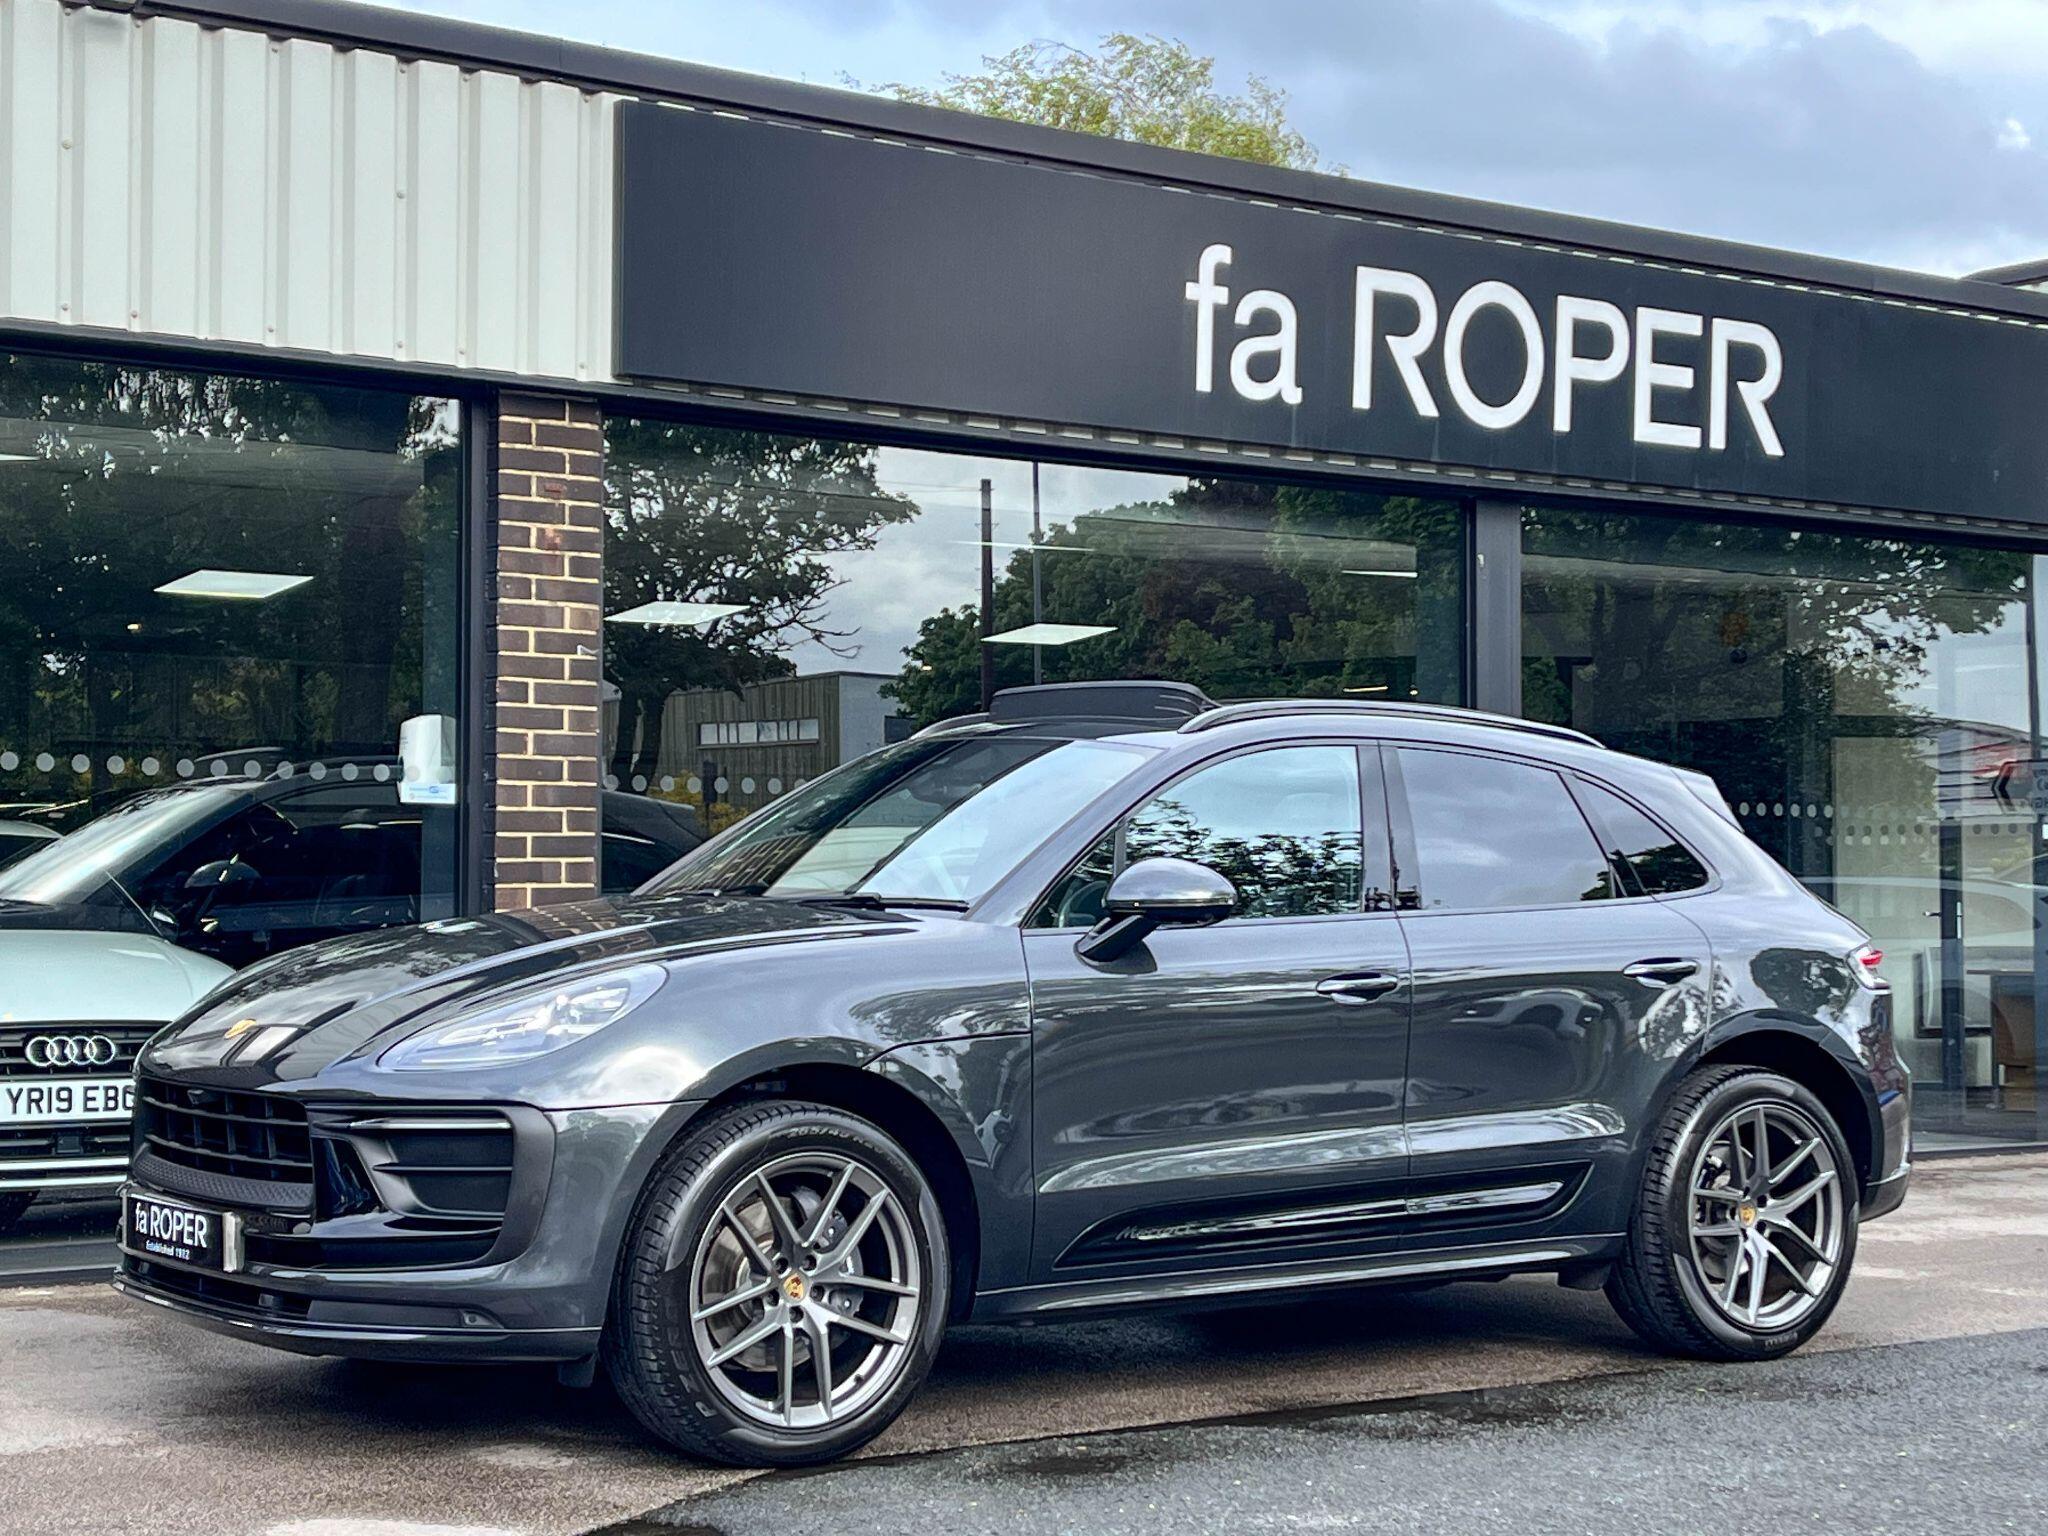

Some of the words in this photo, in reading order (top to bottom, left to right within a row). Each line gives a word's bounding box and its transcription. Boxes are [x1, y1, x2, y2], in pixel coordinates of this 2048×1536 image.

[1185, 243, 1303, 405] fa
[1352, 265, 1785, 457] ROPER
[6, 1086, 73, 1115] YR19
[135, 1202, 148, 1234] fa
[149, 1205, 208, 1249] ROPER
